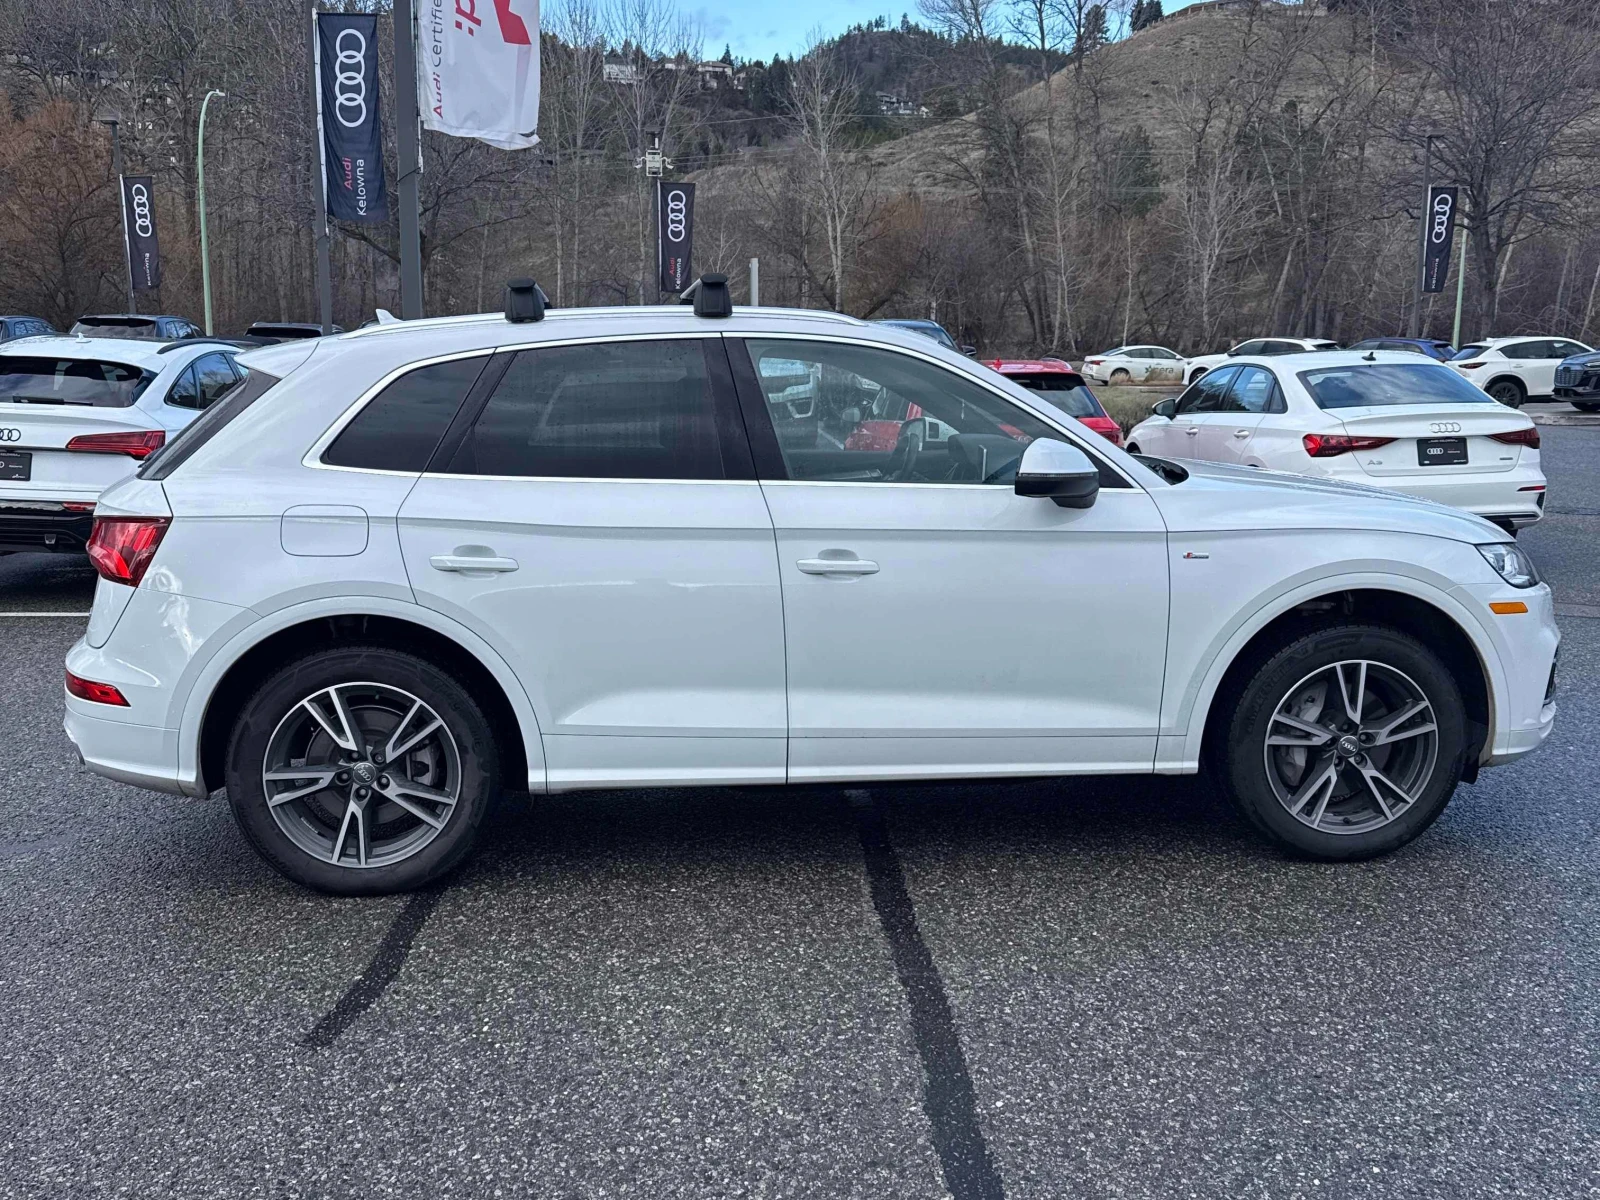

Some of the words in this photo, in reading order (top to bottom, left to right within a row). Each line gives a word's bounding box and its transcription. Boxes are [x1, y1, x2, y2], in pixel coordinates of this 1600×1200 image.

[433, 72, 443, 119] Audi
[342, 157, 353, 190] Audi
[356, 159, 366, 216] Kelowna
[1431, 257, 1440, 289] Kelowna
